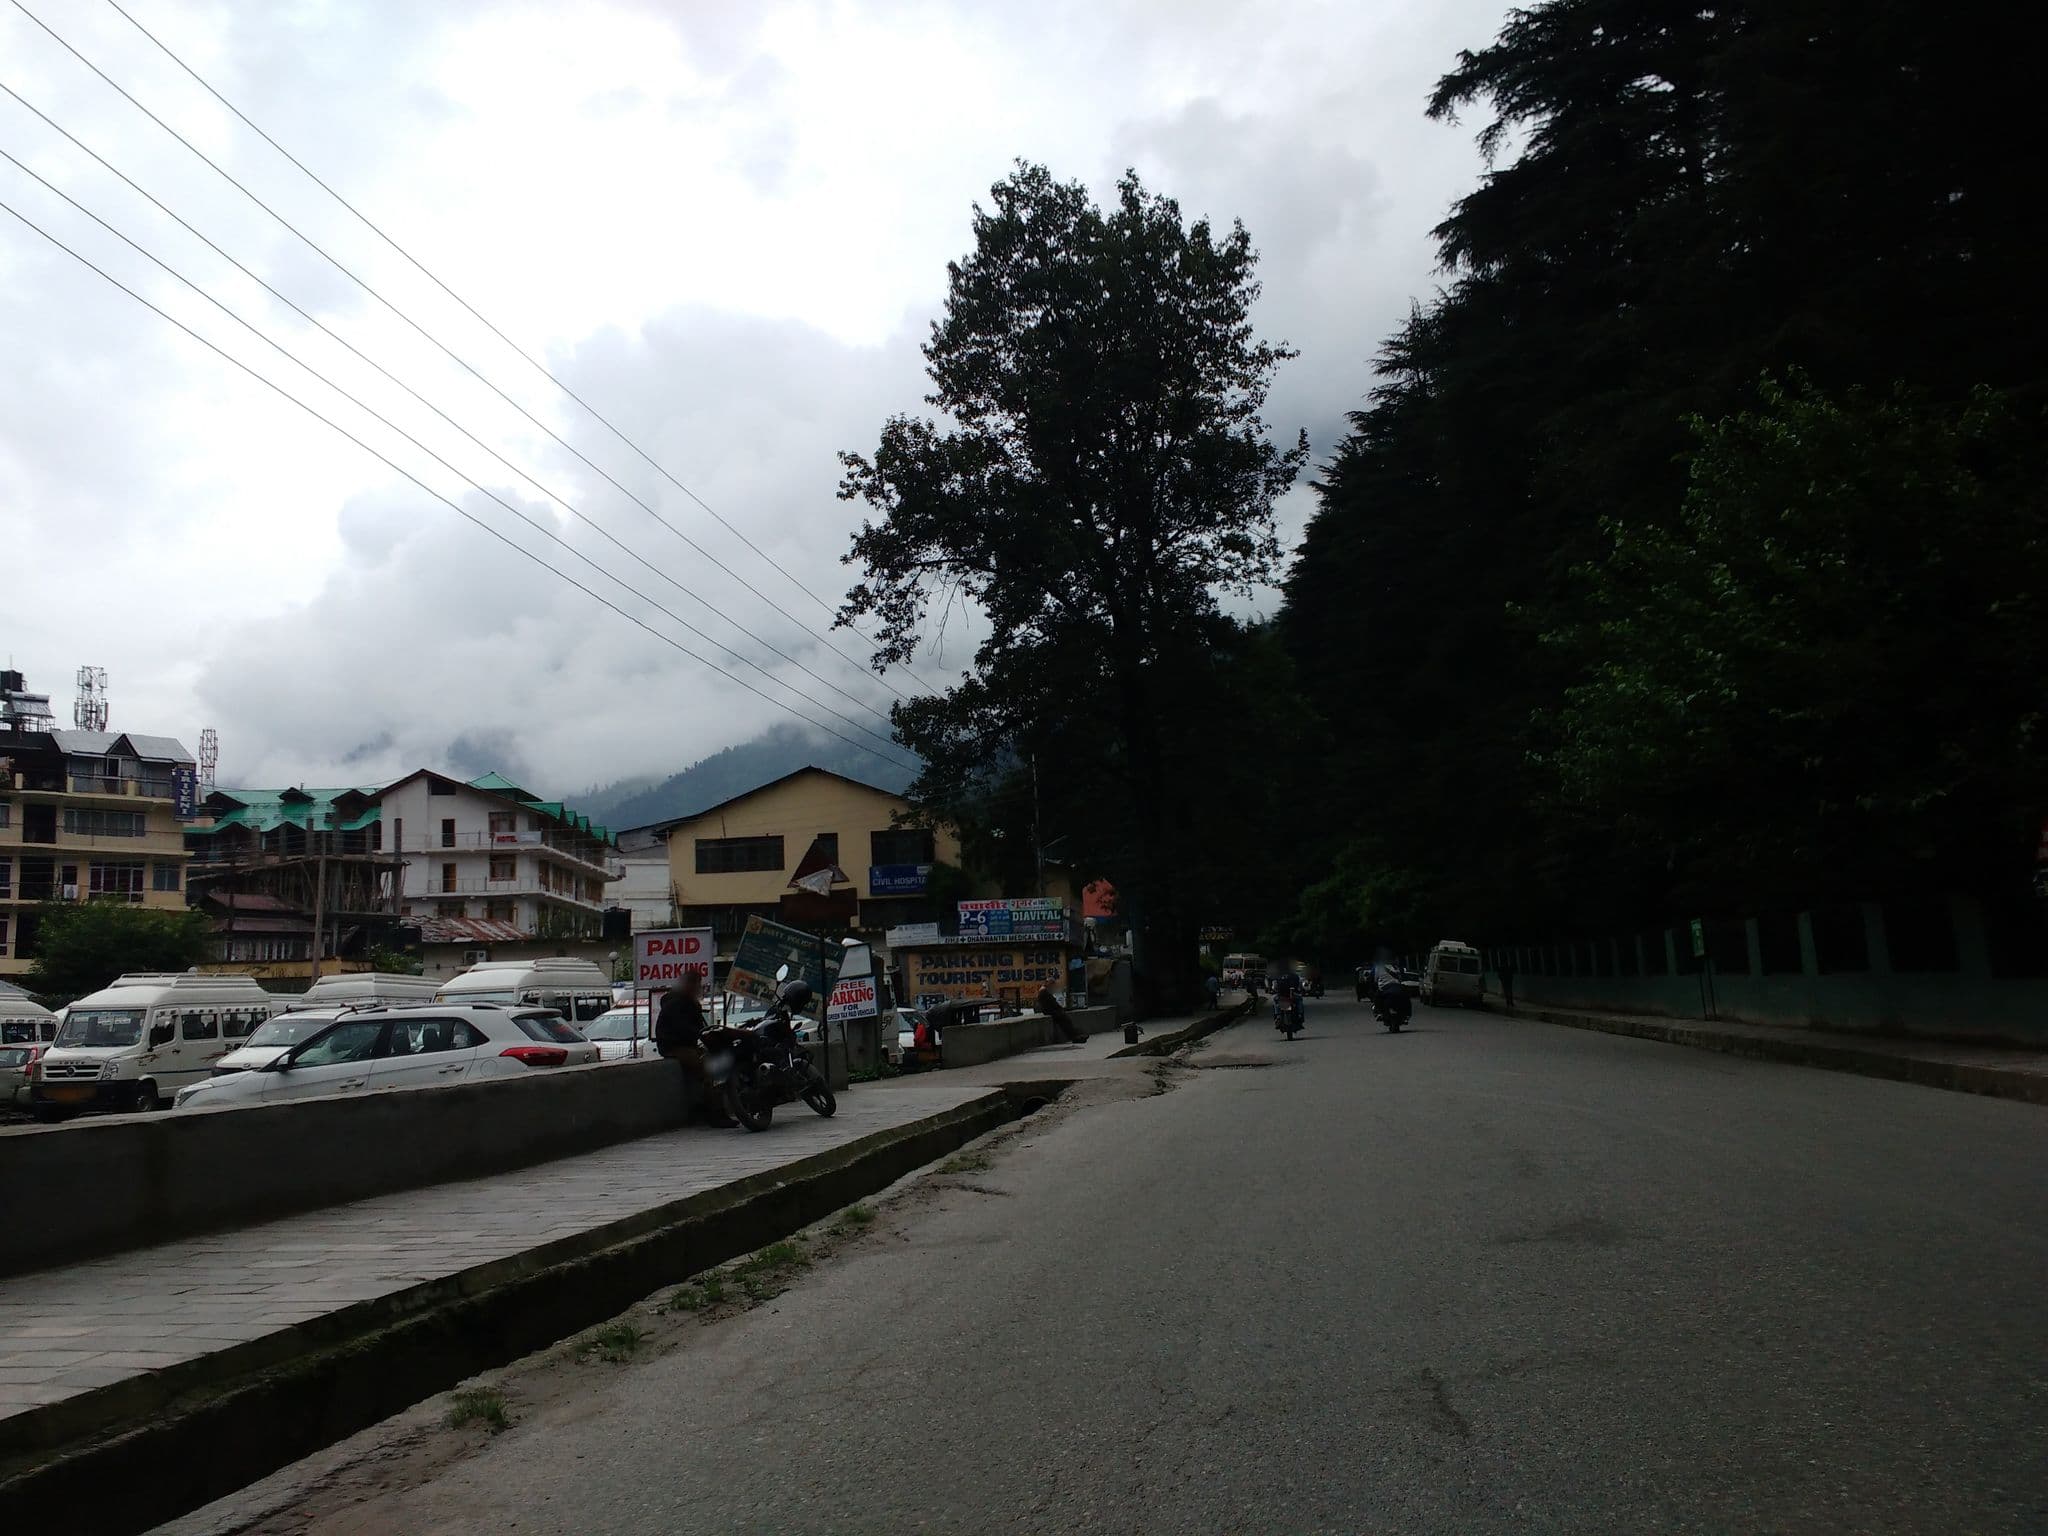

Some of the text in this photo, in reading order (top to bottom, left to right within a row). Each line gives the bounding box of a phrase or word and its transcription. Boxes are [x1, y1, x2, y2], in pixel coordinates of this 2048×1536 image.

[180, 769, 193, 815] TRIVENI
[872, 875, 892, 887] CIVIL
[1012, 910, 1061, 922] DIAVITAL
[1009, 933, 1036, 942] MEDICAL
[1036, 933, 1056, 942] STORE
[647, 937, 700, 956] PAID
[921, 951, 1061, 970] PARKING FOR
[640, 961, 709, 981] PARKING
[916, 969, 994, 985] TOURIST
[833, 980, 866, 990] FREE
[843, 1003, 859, 1011] FOR
